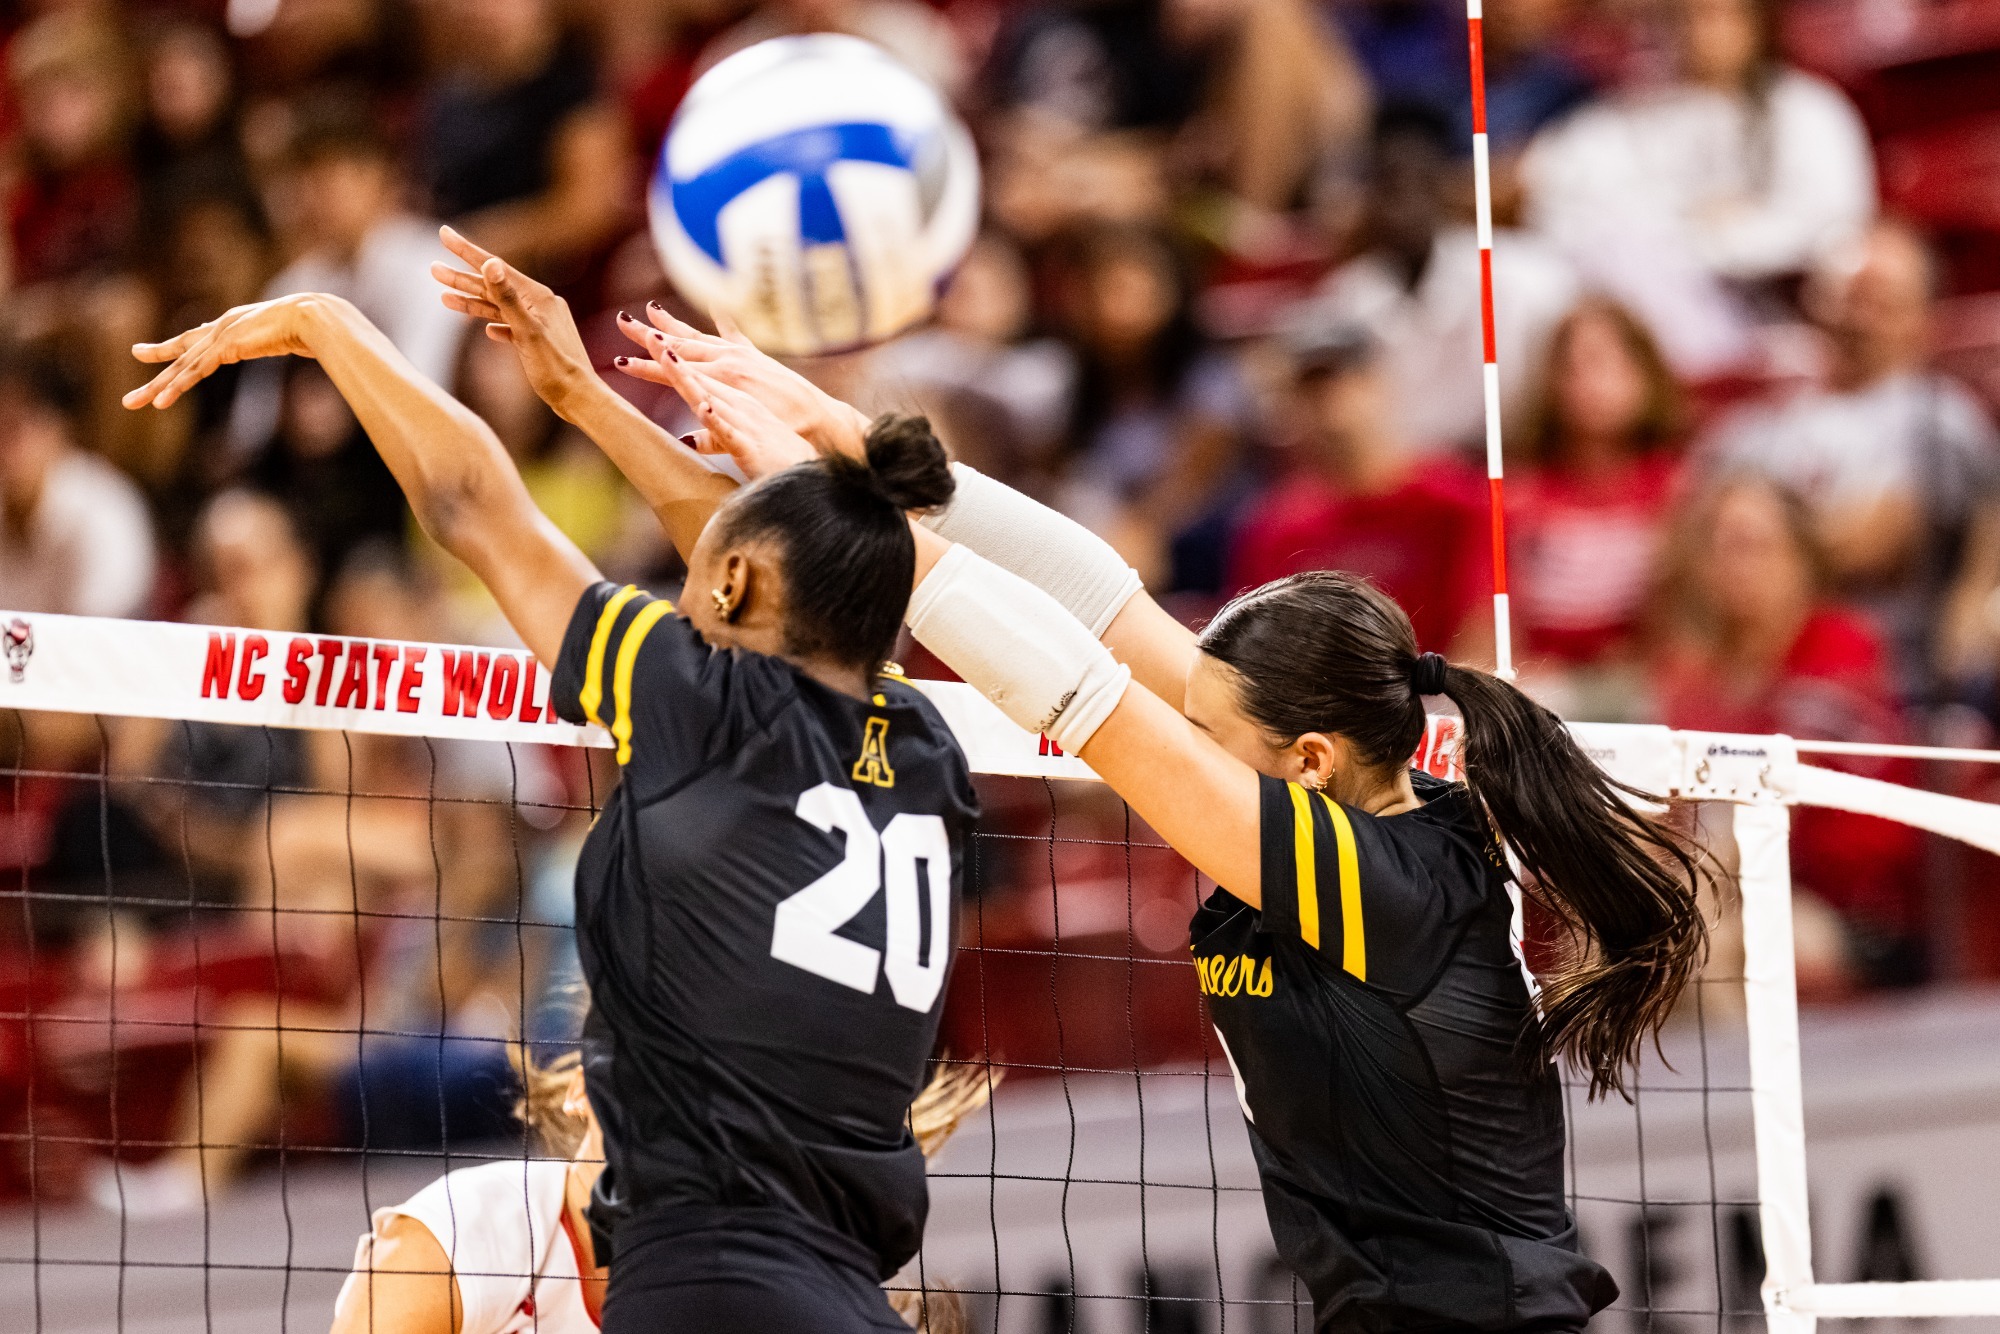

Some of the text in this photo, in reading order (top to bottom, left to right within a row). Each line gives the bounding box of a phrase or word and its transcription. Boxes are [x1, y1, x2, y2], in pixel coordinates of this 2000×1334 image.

[201, 632, 558, 724] NC STATE WOL
[852, 716, 895, 788] A
[770, 781, 951, 1014] 20
